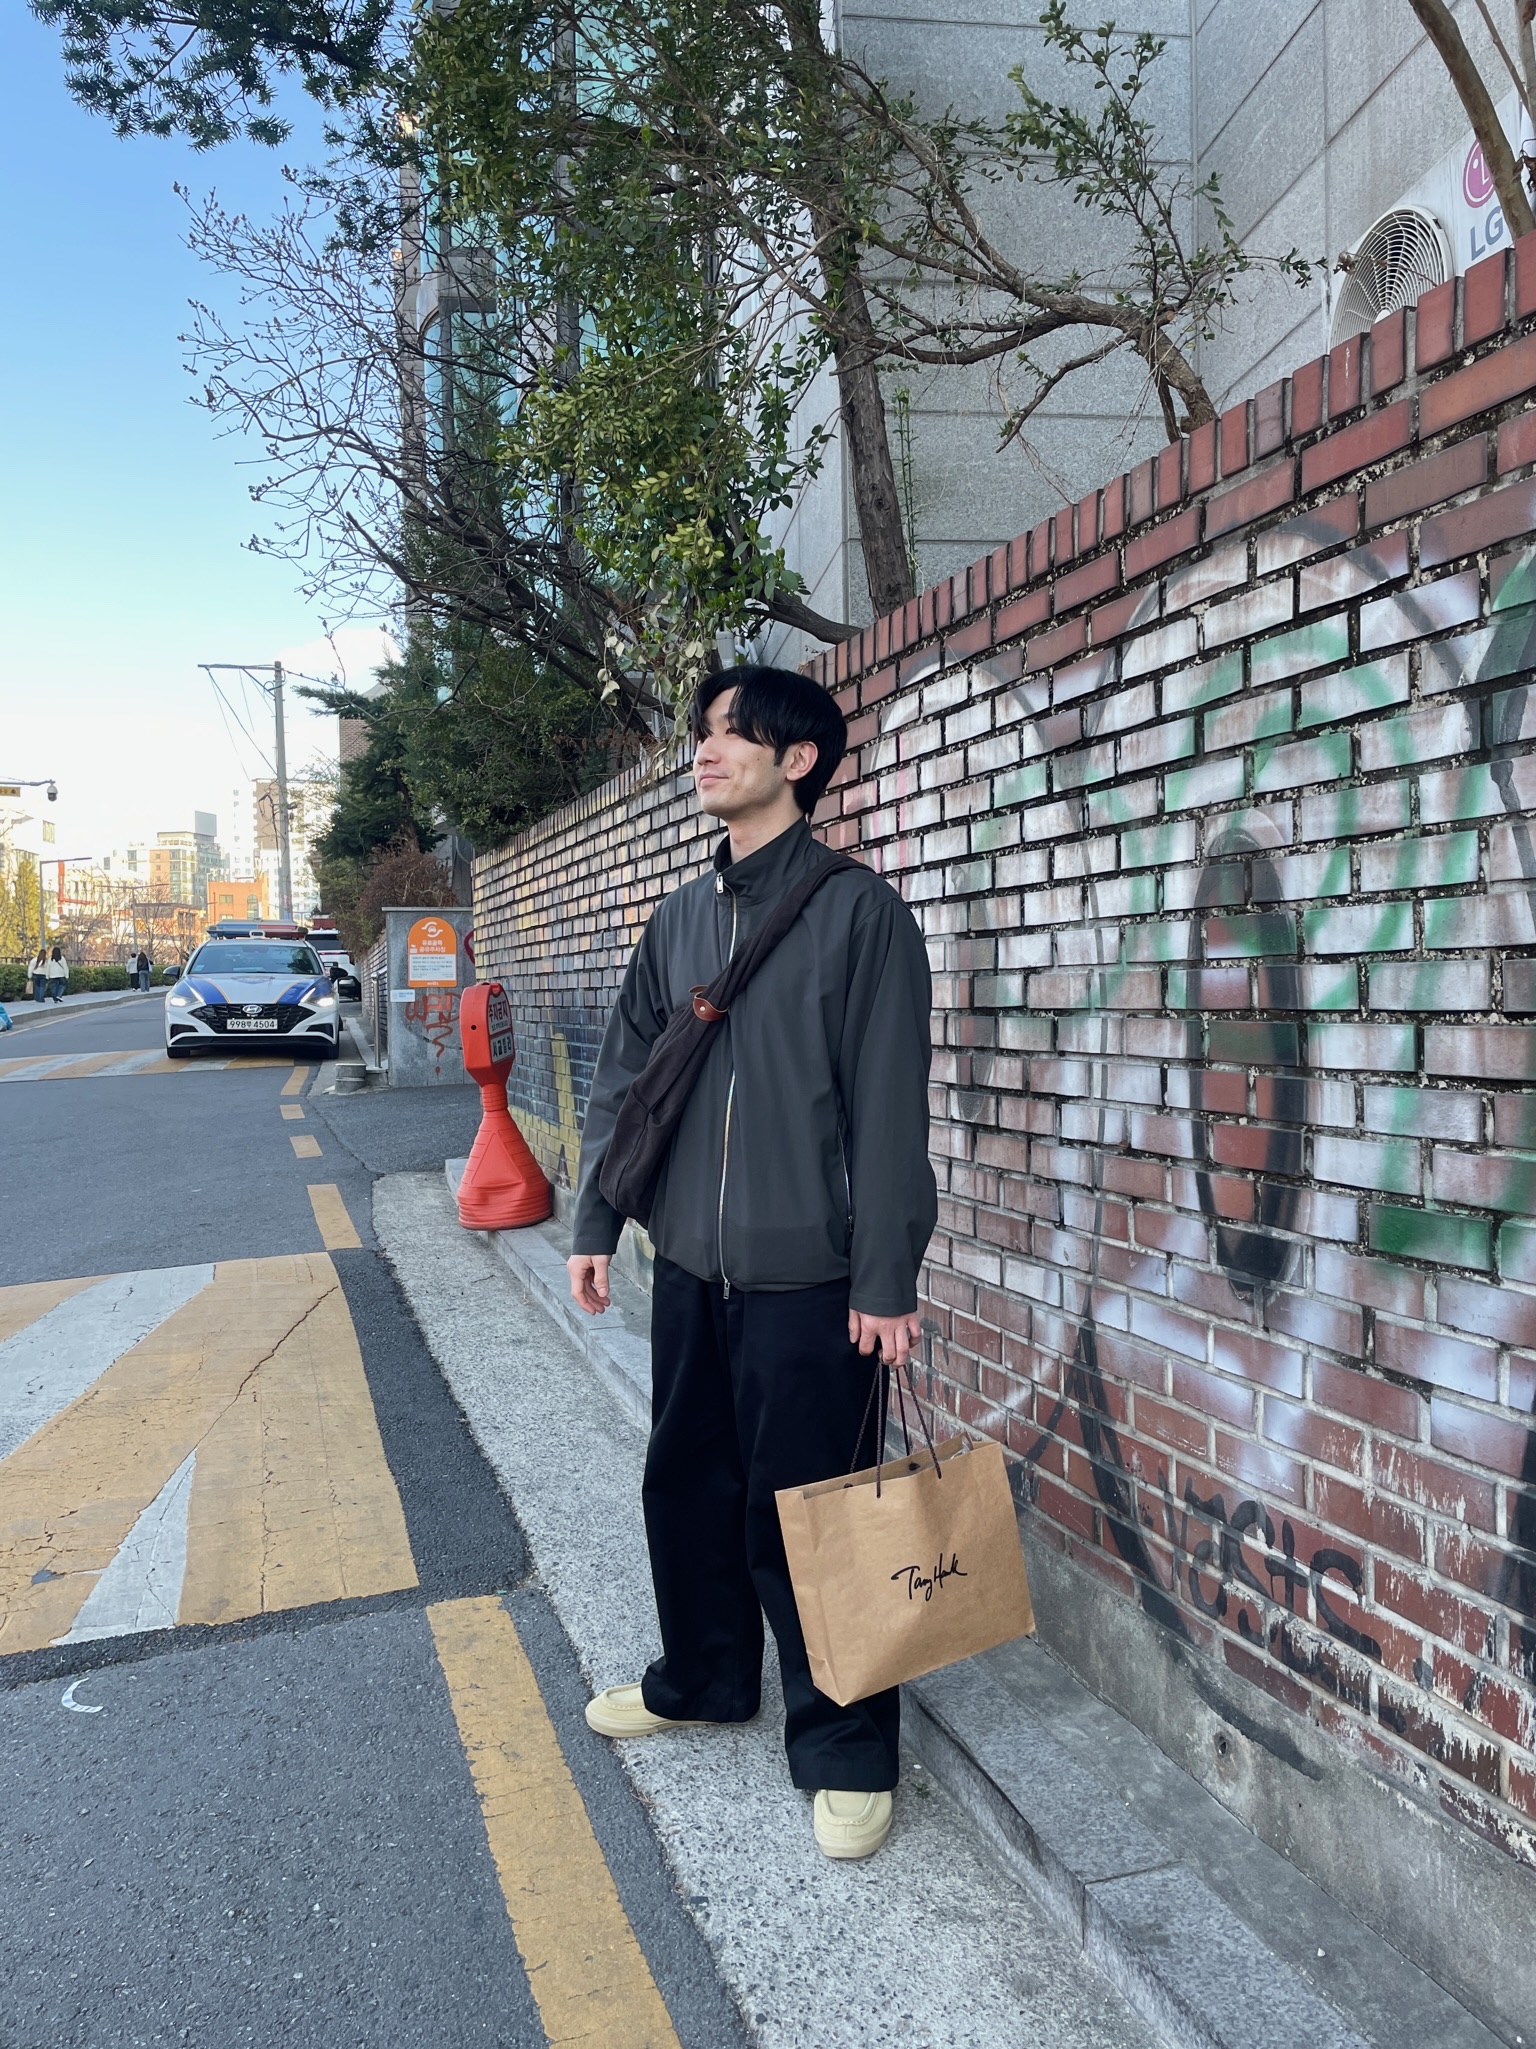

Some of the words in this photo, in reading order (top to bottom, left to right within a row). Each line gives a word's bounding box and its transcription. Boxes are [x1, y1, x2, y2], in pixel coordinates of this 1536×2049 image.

[1470, 205, 1504, 261] LG
[488, 1000, 508, 1022] 주차금지
[253, 1020, 275, 1029] 4504
